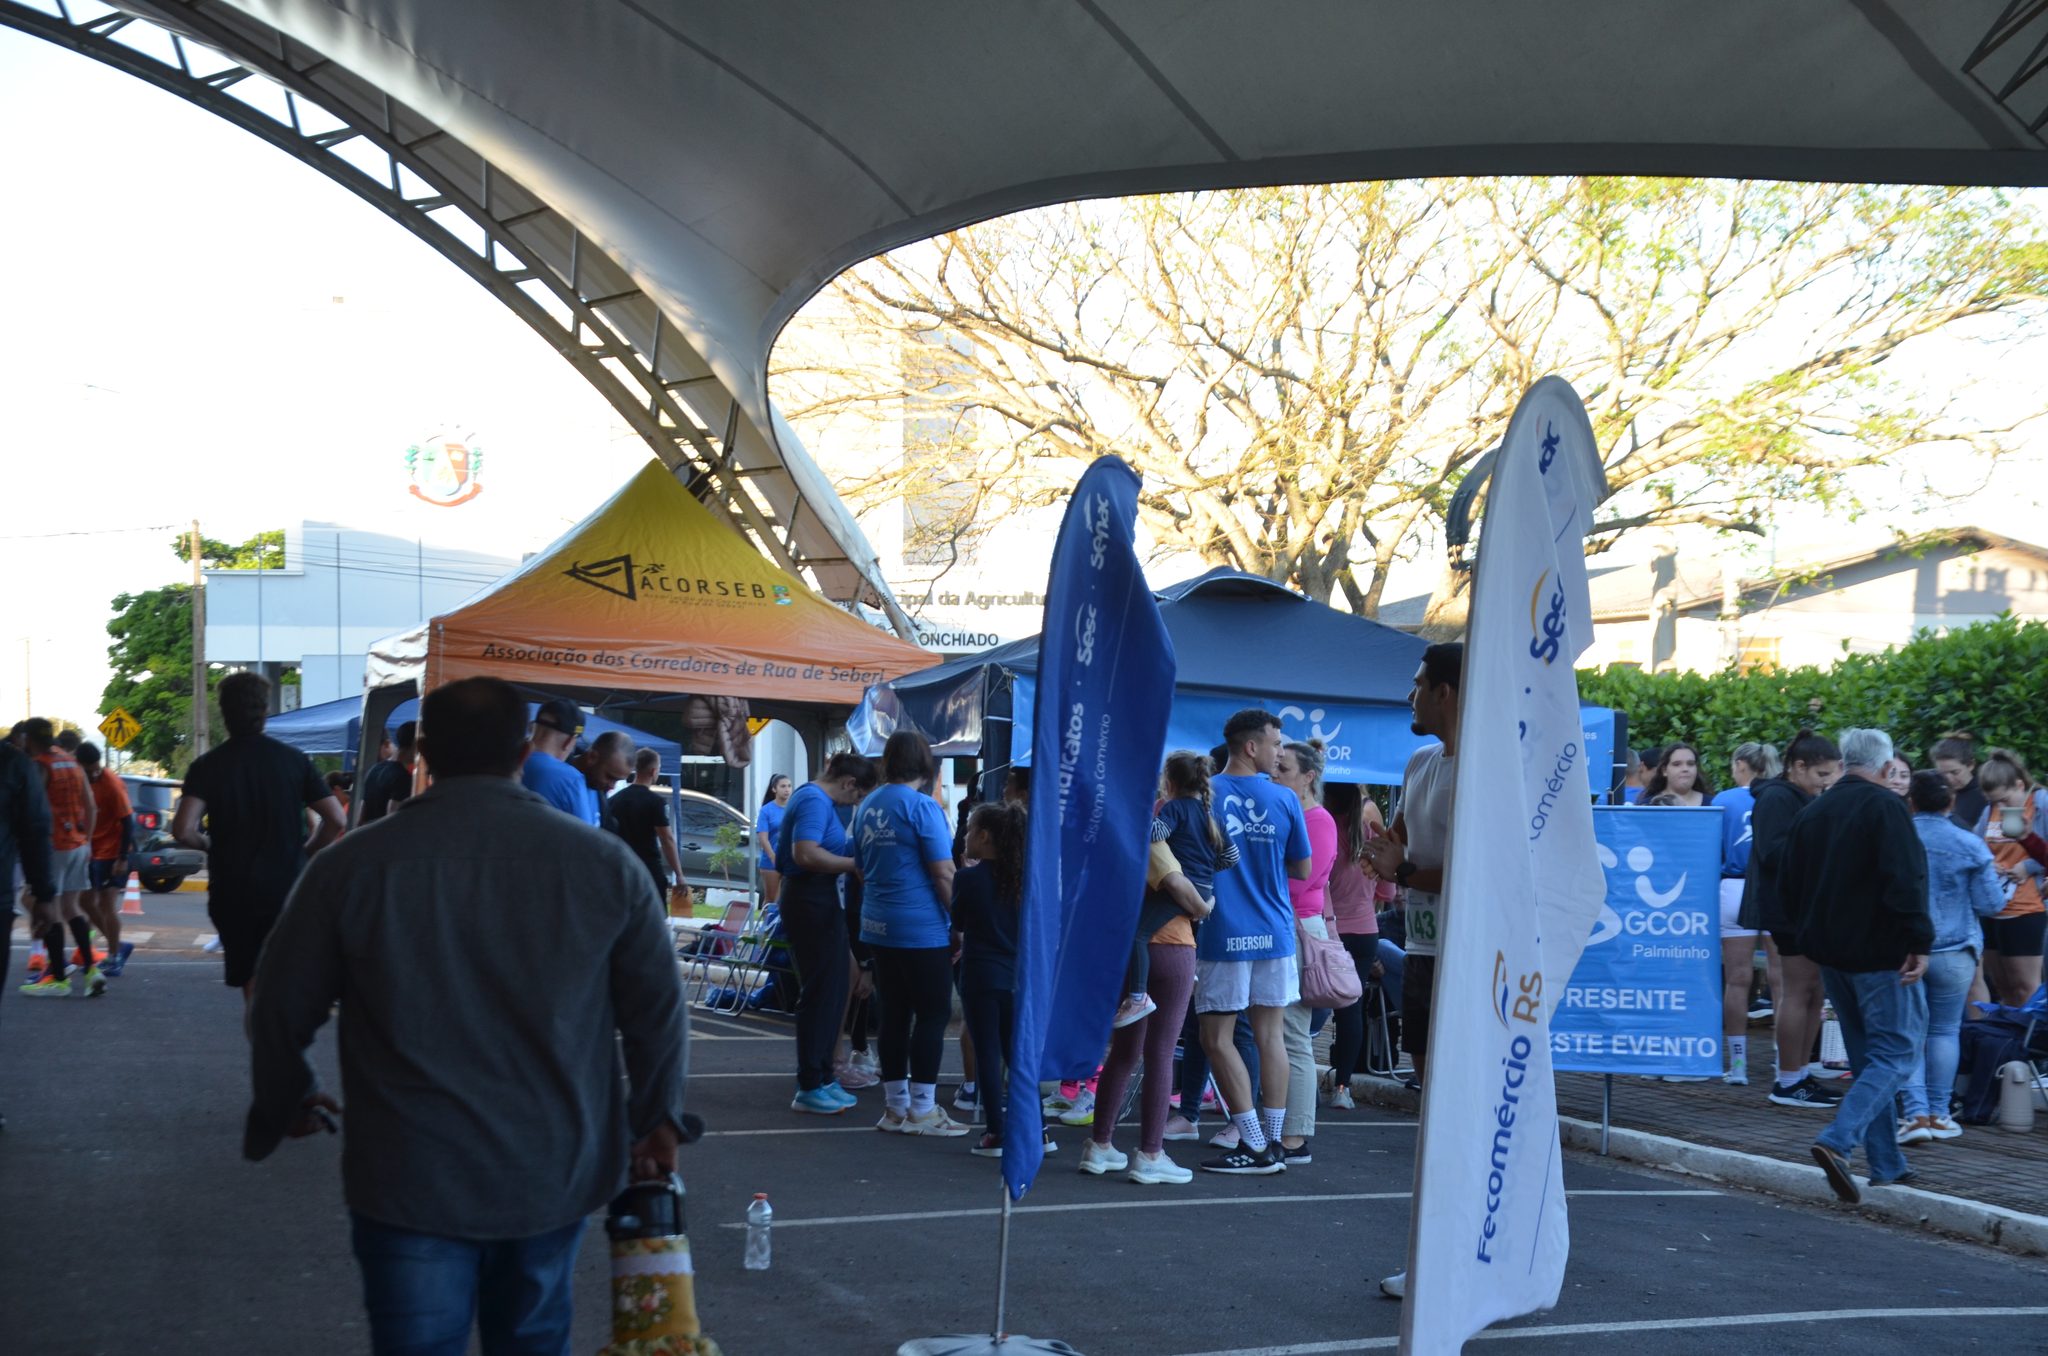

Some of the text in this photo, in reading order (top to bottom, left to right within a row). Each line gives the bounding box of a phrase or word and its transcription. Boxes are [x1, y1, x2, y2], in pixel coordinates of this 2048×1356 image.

[641, 576, 766, 599] ACORSEB
[1076, 603, 1097, 667] Sesc
[1089, 492, 1109, 571] Senac
[938, 590, 960, 606] da
[481, 643, 885, 684] Associação dos Corredores de Rua de Seberi
[1323, 745, 1352, 760] OR
[1083, 783, 1106, 844] Sistema
[1244, 823, 1276, 834] GCOR
[1624, 911, 1710, 936] GCOR
[1632, 944, 1711, 959] Palmitinho
[1561, 988, 1687, 1011] RESENTE
[1612, 1034, 1718, 1058] EVENTO
[1476, 970, 1543, 1265] Fecomércio RS
